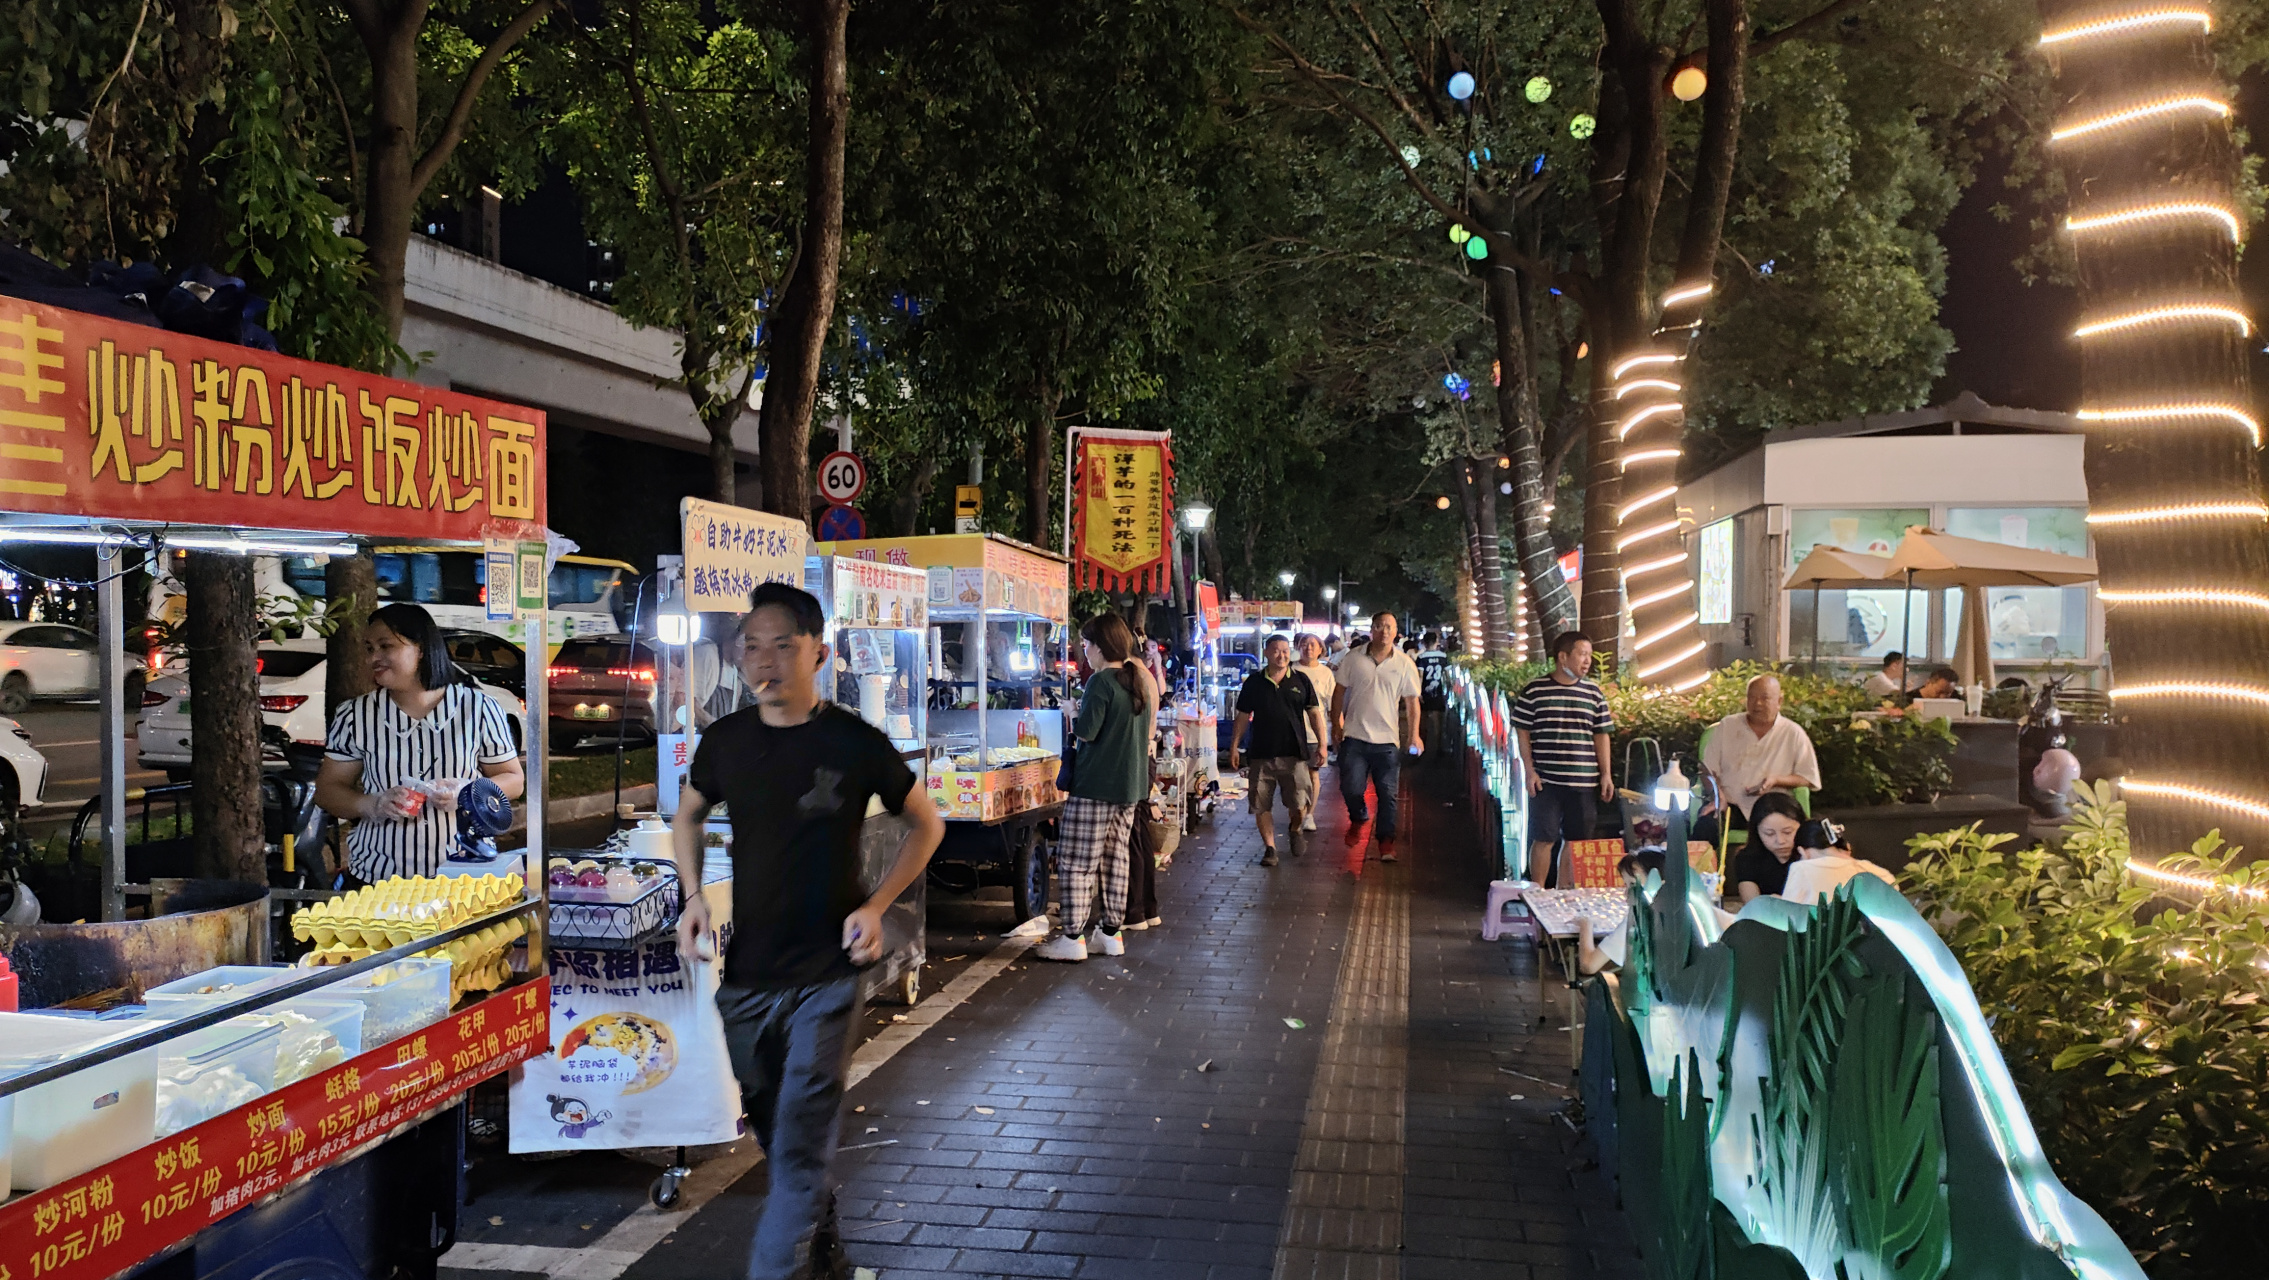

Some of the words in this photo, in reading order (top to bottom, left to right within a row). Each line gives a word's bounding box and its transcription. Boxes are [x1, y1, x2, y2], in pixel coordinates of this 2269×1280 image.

[88, 339, 536, 521] 炒粉炒饭炒面
[828, 464, 856, 489] 60
[1111, 453, 1136, 552] 洋芋的一百种死法
[580, 984, 599, 994] TO
[605, 987, 639, 997] MEET
[648, 980, 683, 995] YOU
[30, 1211, 125, 1278] 10元/份
[141, 1166, 223, 1225] 10元/份
[236, 1127, 307, 1179] 10元/份
[318, 1091, 380, 1139] 15元/份
[390, 1059, 445, 1105] 20元/份
[452, 1033, 500, 1073] 20元/份
[504, 1011, 546, 1047] 20元/份
[33, 1174, 114, 1236] 炒河粉
[154, 1137, 202, 1181] 炒饭
[247, 1099, 287, 1139] 炒面
[325, 1067, 361, 1103] 蚝烙
[396, 1035, 429, 1069] 田螺
[458, 1009, 486, 1041] 花甲
[512, 987, 537, 1015] 丁螺
